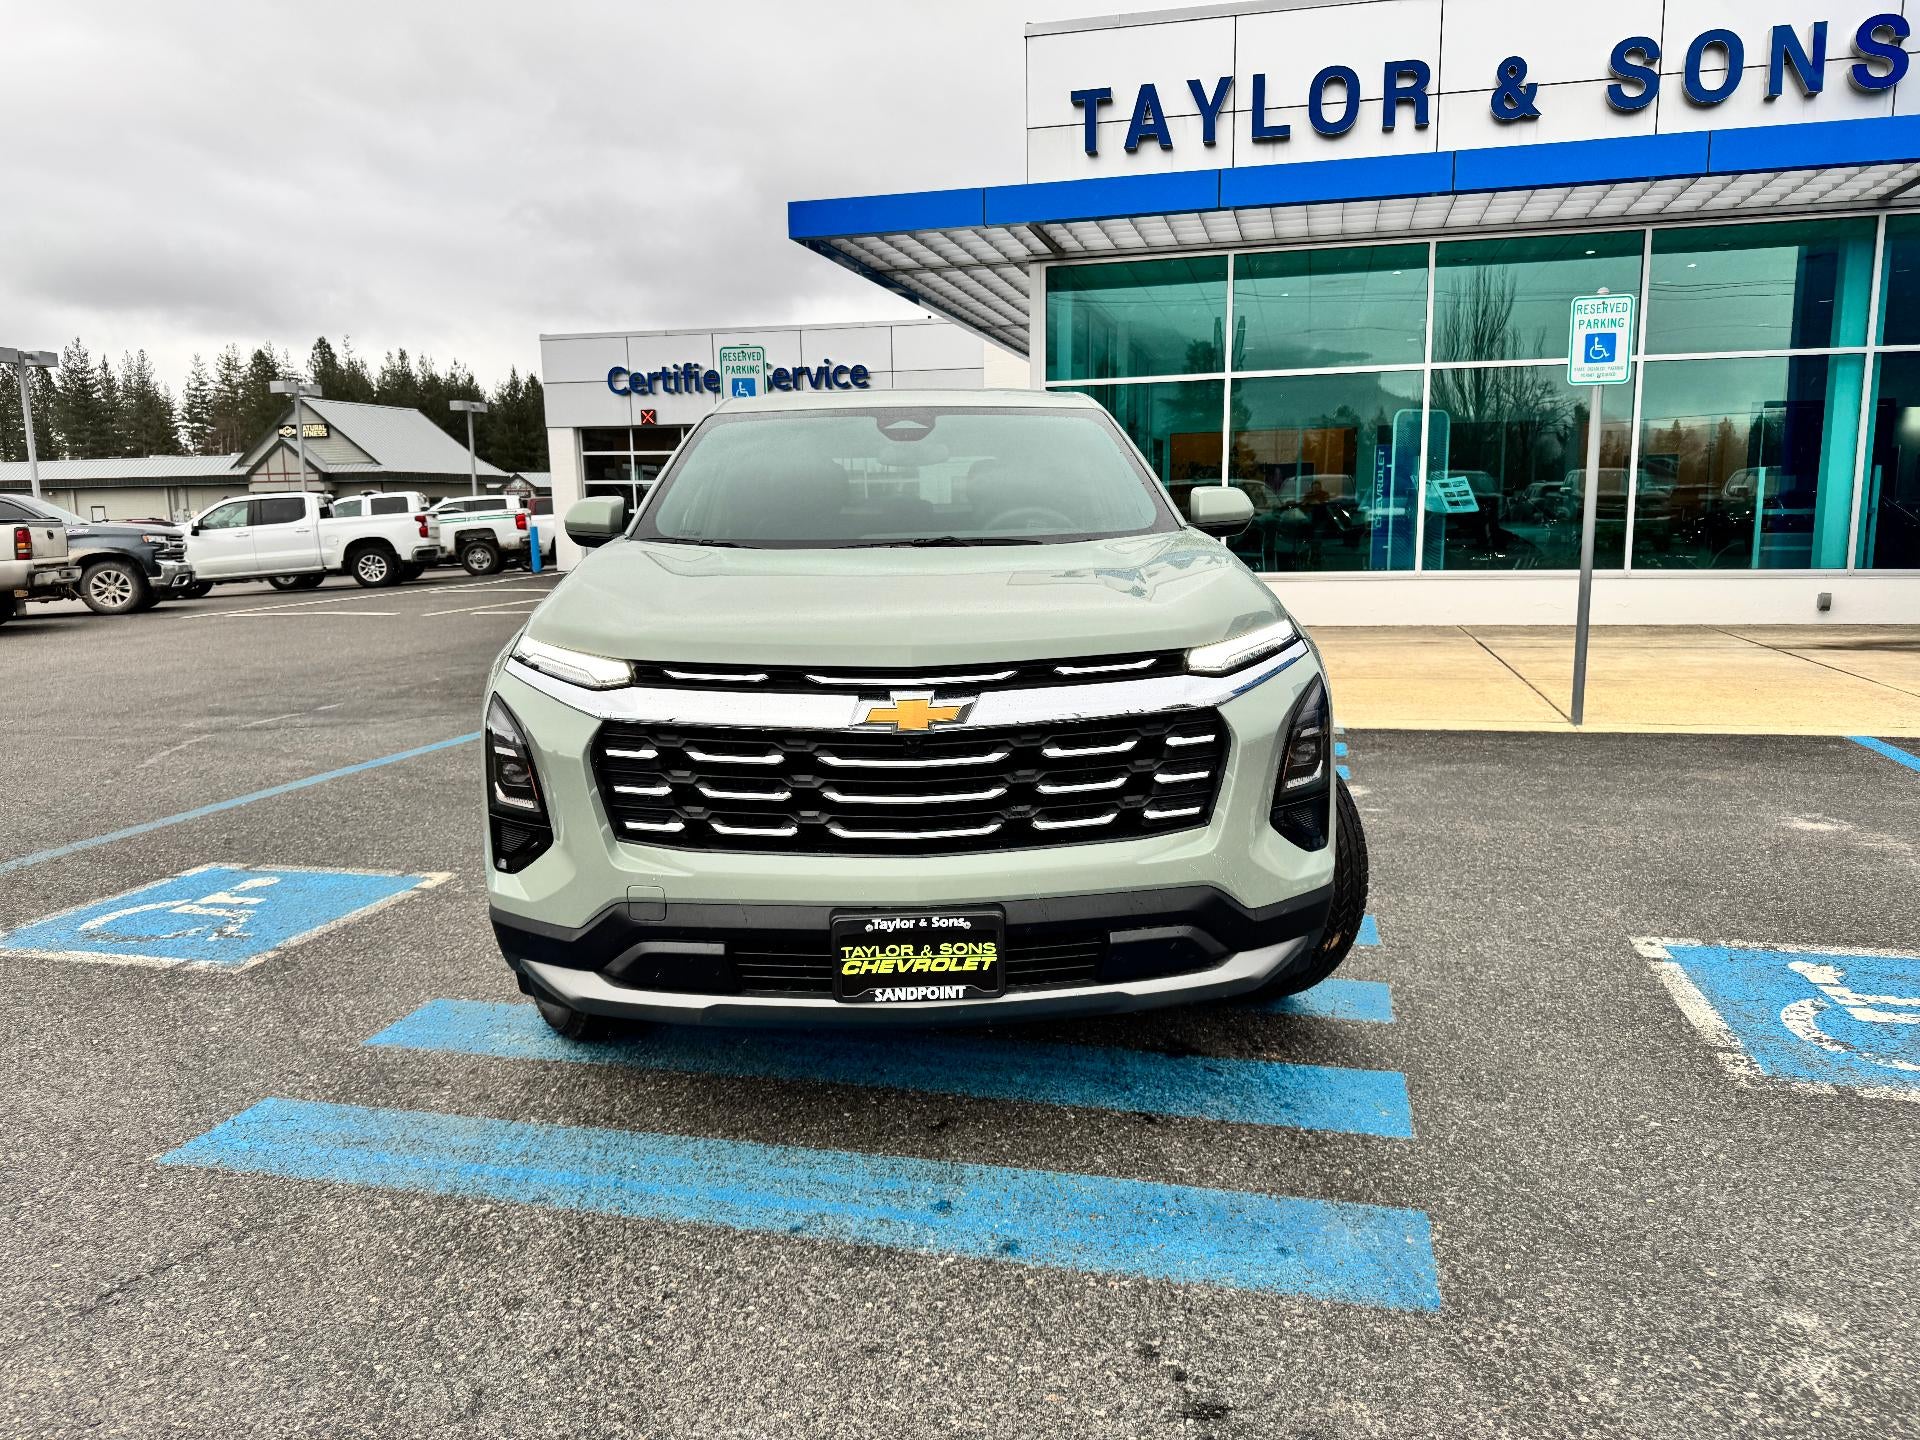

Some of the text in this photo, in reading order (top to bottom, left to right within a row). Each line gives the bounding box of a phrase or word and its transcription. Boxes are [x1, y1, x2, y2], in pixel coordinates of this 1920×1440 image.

[1070, 13, 1912, 155] TAYLOR & SONS
[1576, 302, 1628, 315] RESERVED
[1578, 317, 1625, 330] PARKING
[722, 351, 762, 362] RESERVED
[607, 358, 869, 396] Certifie ervice
[725, 364, 760, 375] PARKING
[871, 917, 965, 932] Taylor & Sons
[840, 942, 997, 958] TAYLOR & SONS
[841, 957, 997, 975] CHEVROLET
[874, 985, 967, 1002] SANDPOINT
